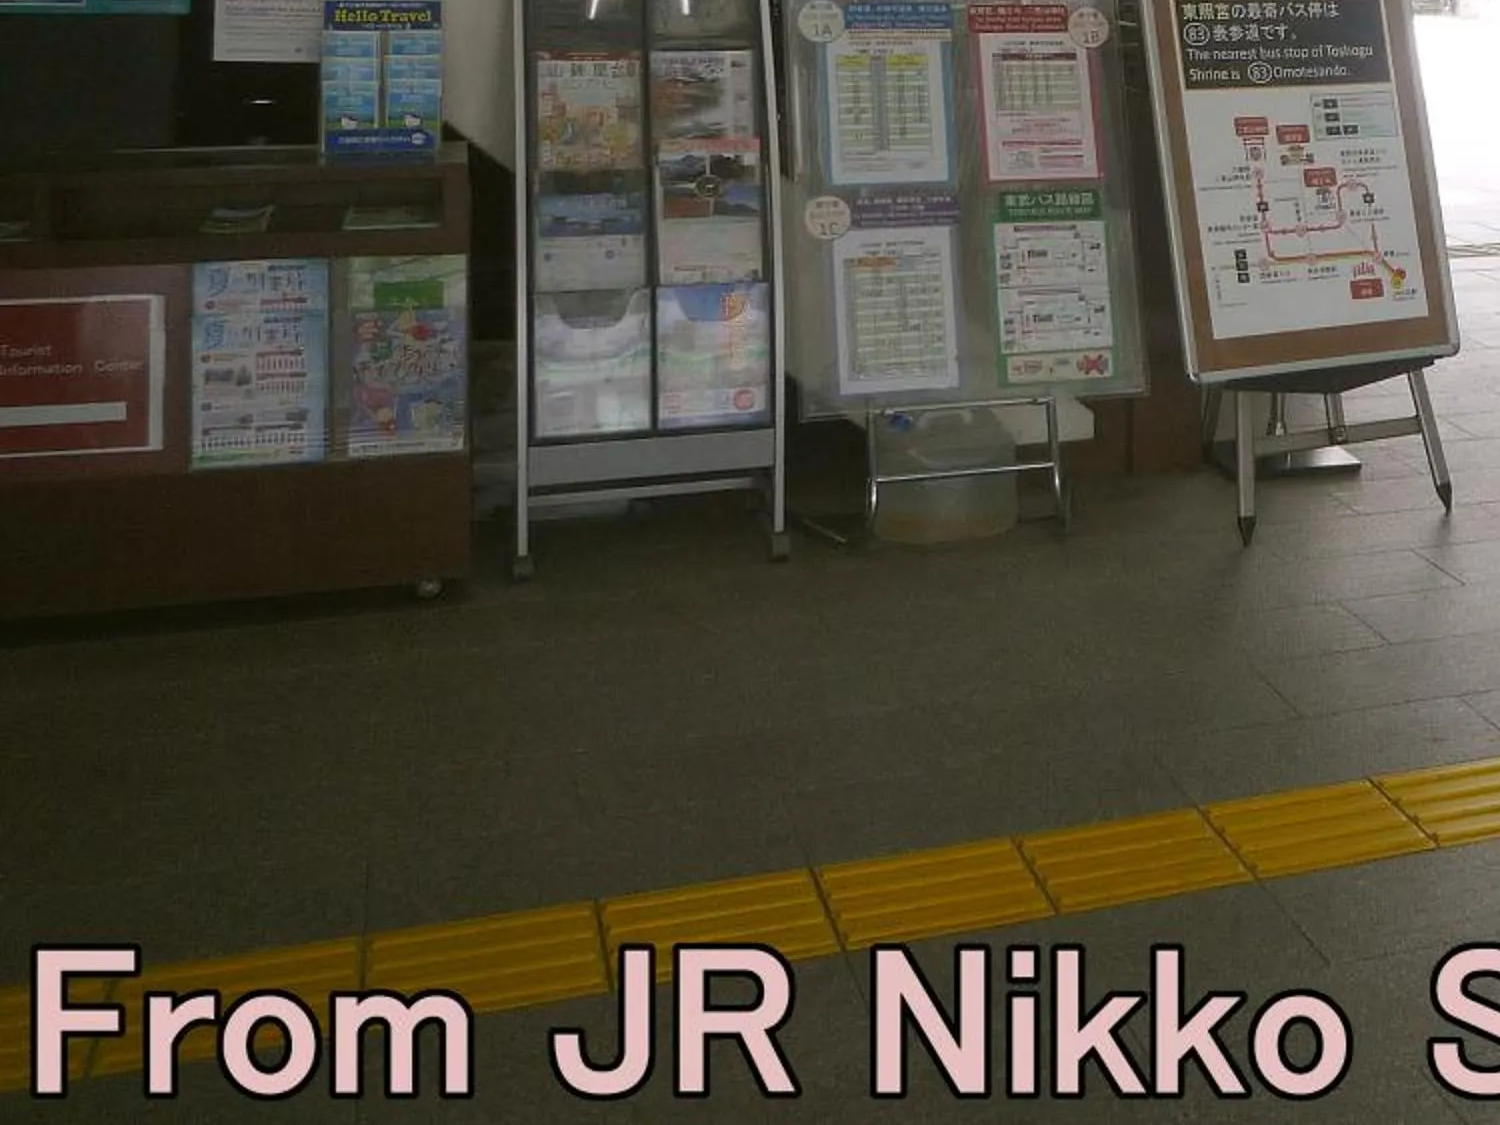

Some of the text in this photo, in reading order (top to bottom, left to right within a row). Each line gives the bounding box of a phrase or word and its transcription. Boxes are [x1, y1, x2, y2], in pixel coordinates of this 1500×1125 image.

[335, 9, 432, 23] Hello Travel
[1182, 1, 1341, 21] 東照宮の最寄バス停は
[1187, 44, 1374, 61] The nearest bus stop of Toshogu
[1189, 67, 1229, 81] Shrine
[1230, 68, 1241, 80] is
